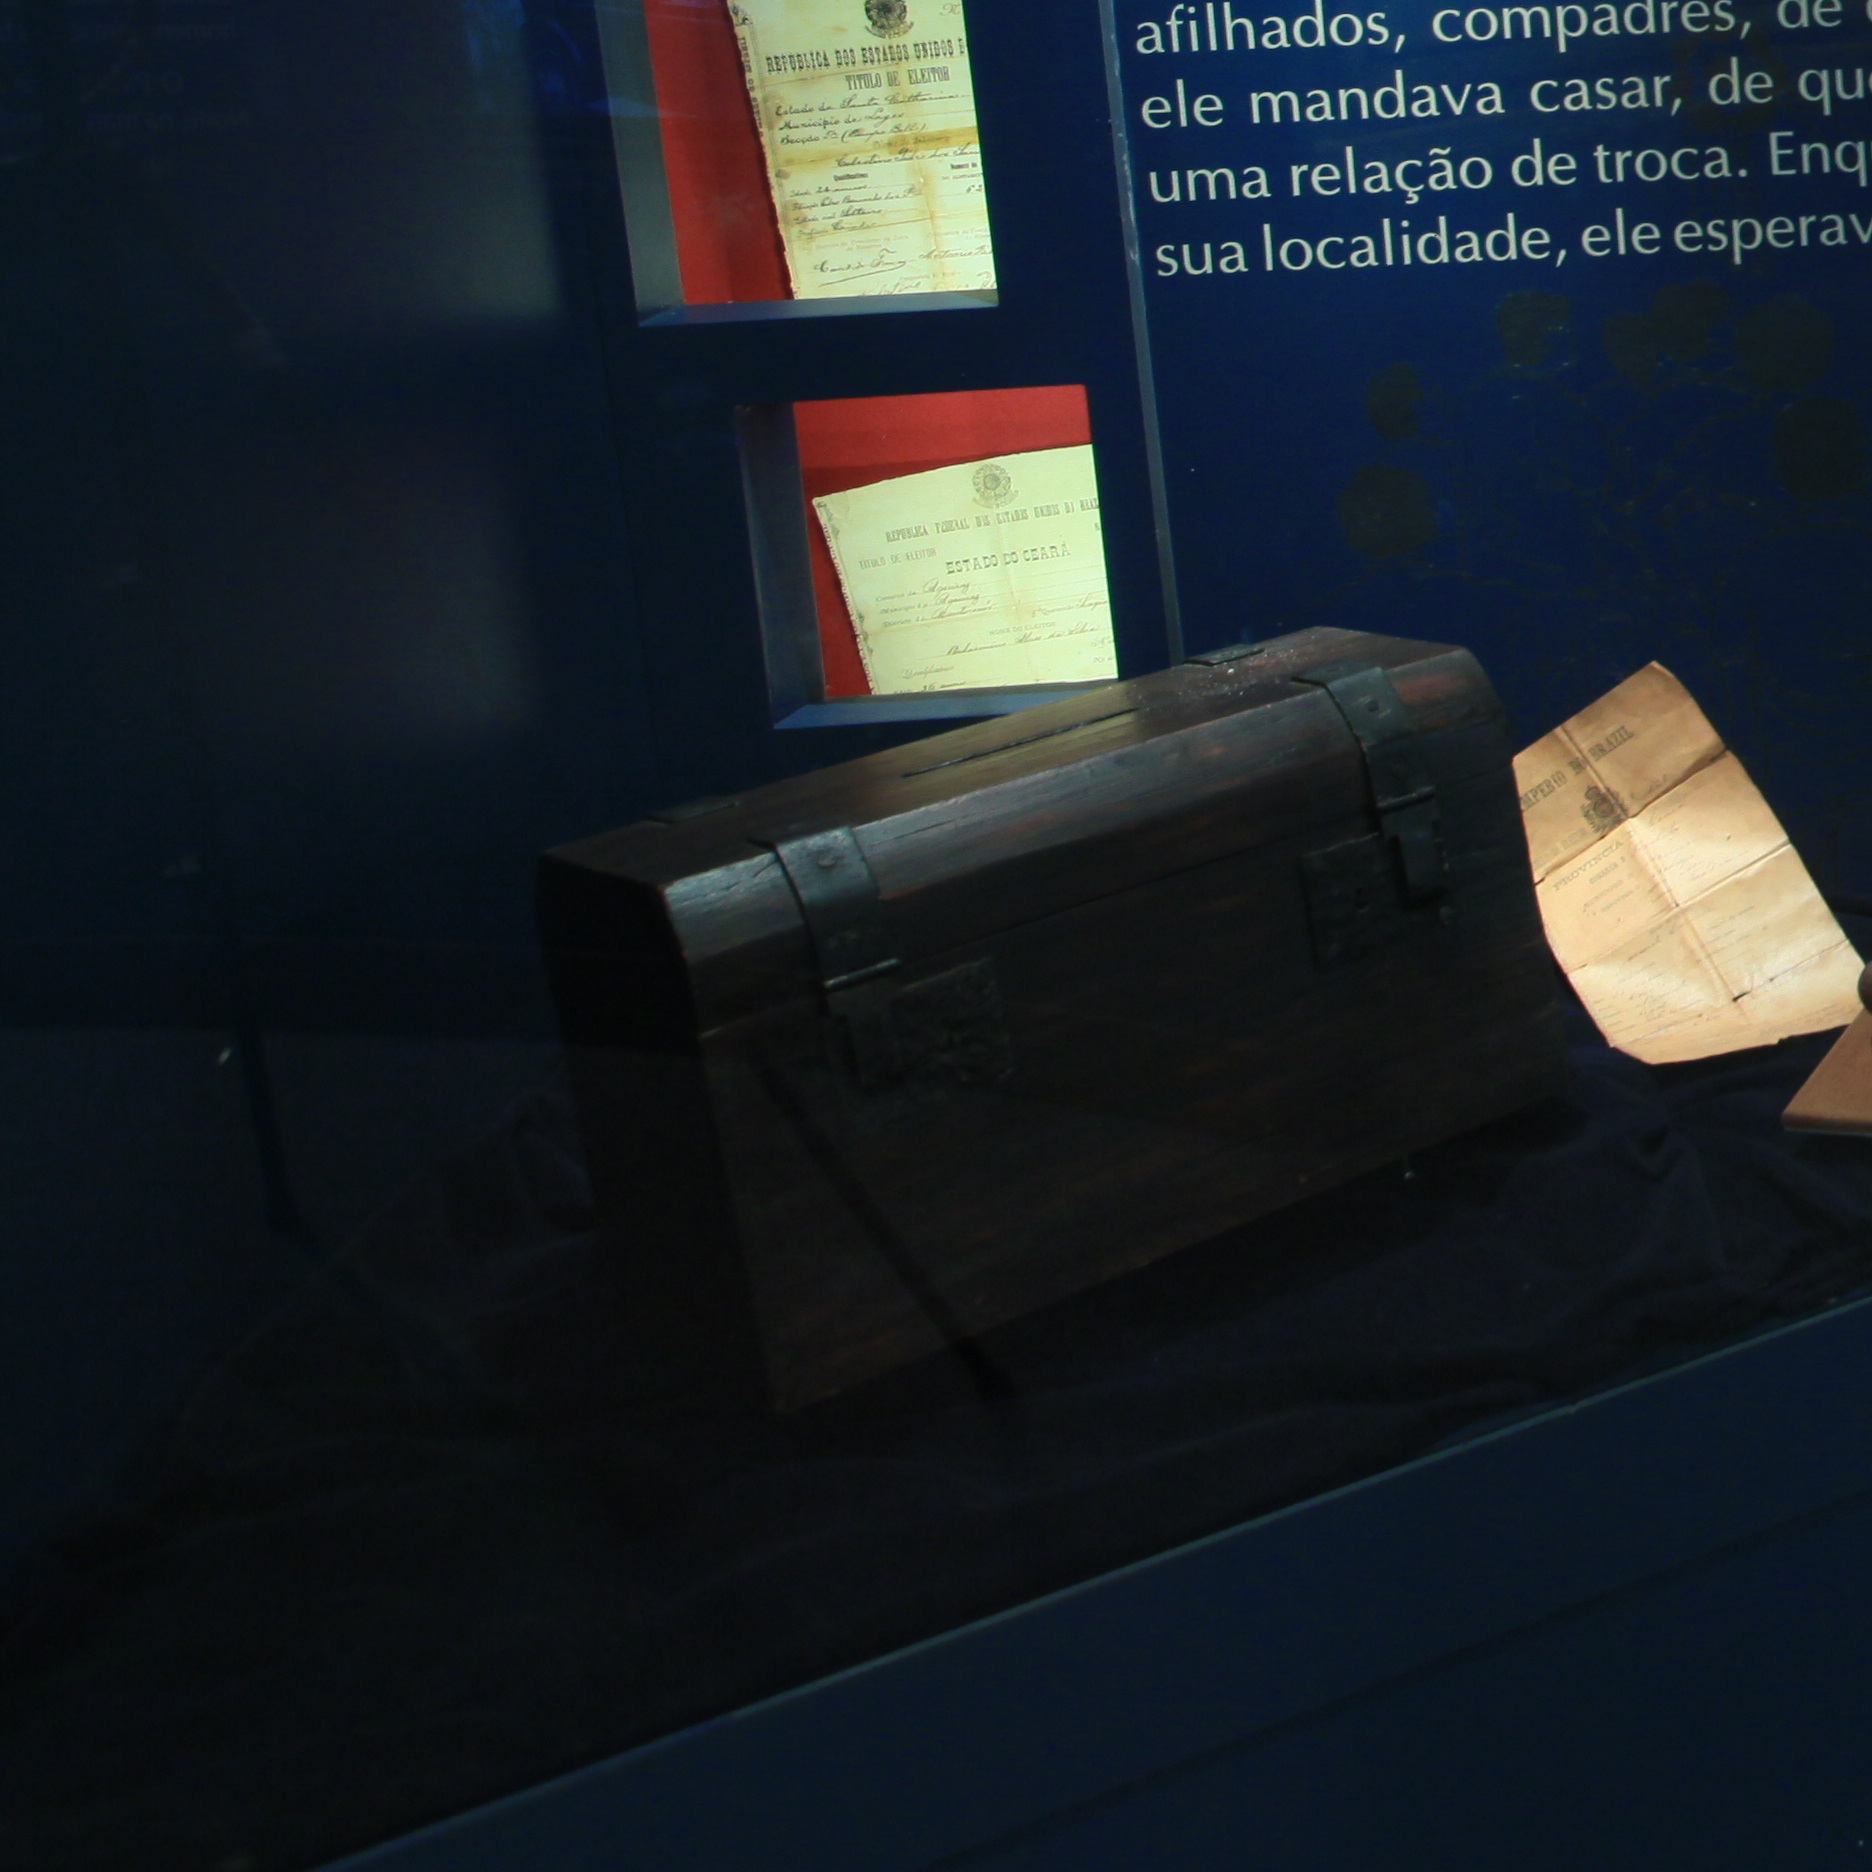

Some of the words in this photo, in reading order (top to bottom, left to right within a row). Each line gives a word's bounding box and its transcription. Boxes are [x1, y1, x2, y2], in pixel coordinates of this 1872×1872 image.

[1154, 240, 1250, 278] sua
[1261, 211, 1568, 273] localidade,
[1580, 206, 1662, 258] ele
